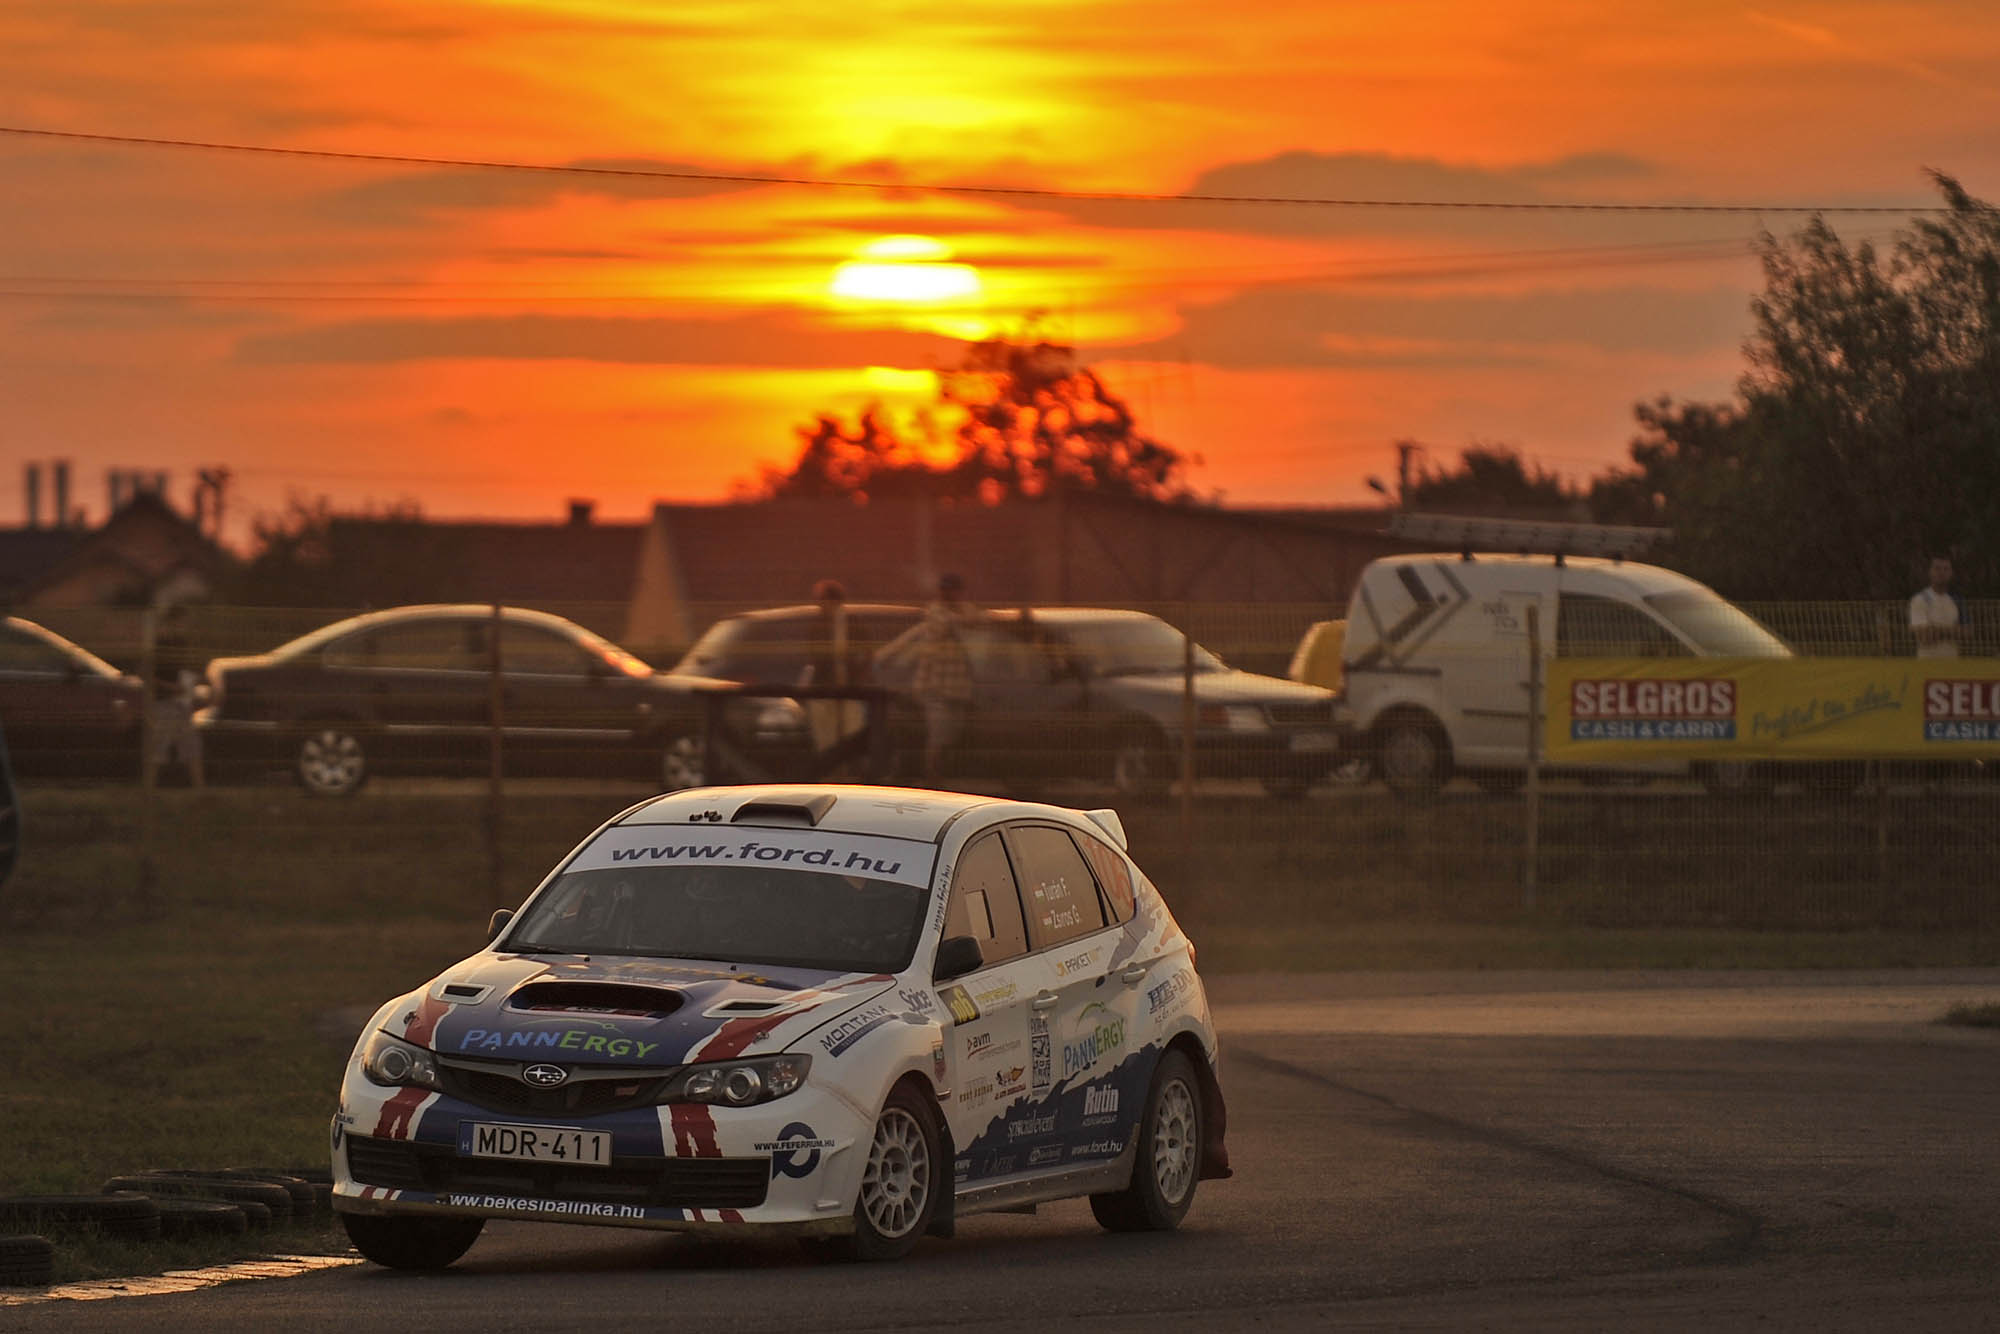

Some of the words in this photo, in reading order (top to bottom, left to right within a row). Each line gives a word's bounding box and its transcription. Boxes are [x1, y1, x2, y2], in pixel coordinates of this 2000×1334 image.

[1573, 681, 1734, 716] SELGROS
[1576, 721, 1635, 738] CASH
[1640, 721, 1655, 738] &
[1658, 721, 1731, 738] CARRY
[1929, 721, 1989, 738] CASH
[612, 842, 902, 875] www.ford.hu
[898, 987, 933, 1012] Spice
[819, 1004, 891, 1051] MONTANA
[973, 1032, 991, 1048] avm
[1084, 1083, 1120, 1116] Rutin
[461, 1140, 470, 1151] H
[478, 1127, 601, 1162] MDR-411
[753, 1139, 836, 1151] WWW.FEFERRUM.HU
